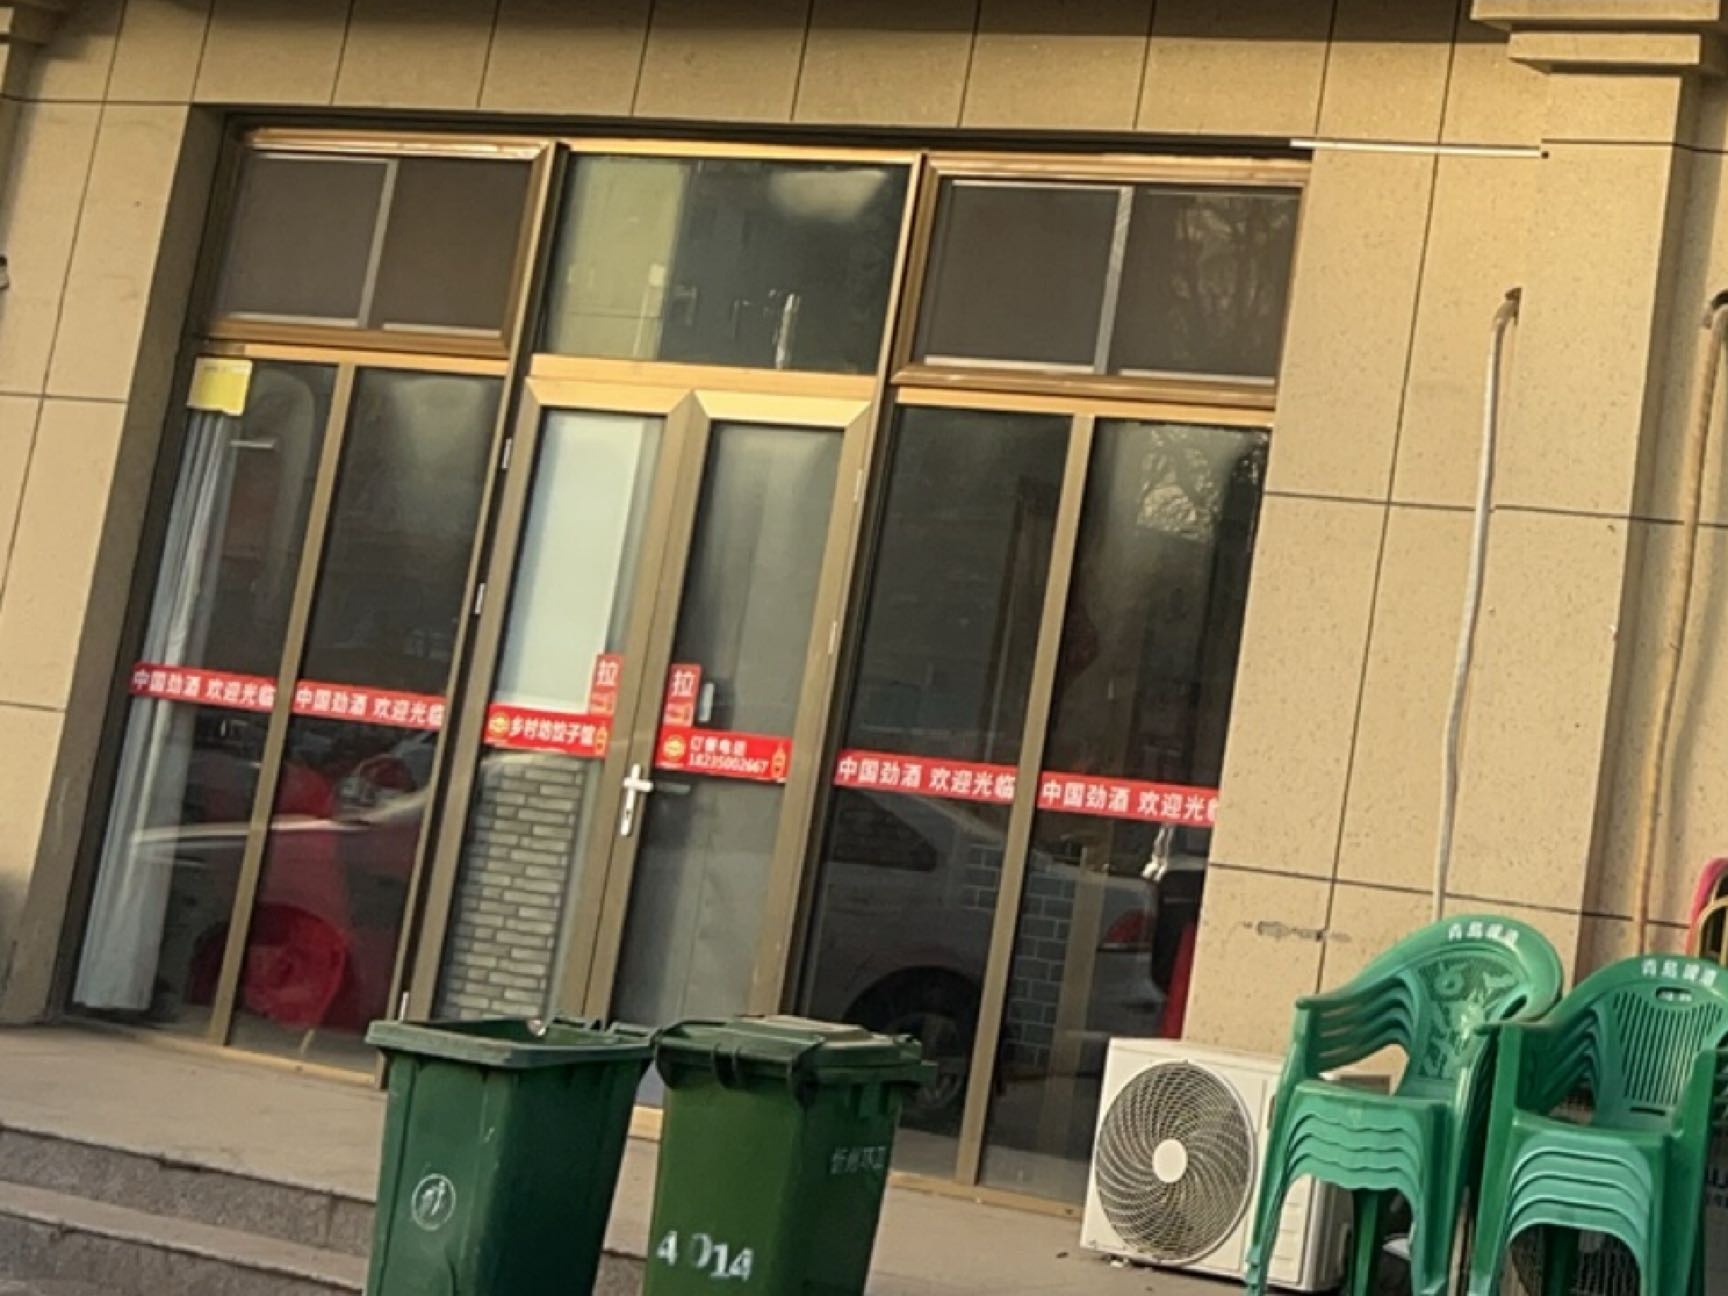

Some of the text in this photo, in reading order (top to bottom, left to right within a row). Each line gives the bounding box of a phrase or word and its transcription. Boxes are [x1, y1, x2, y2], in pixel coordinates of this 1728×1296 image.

[205, 676, 275, 708] 欢迎光临
[670, 669, 694, 696] 拉
[373, 696, 446, 727] 欢迎光临
[838, 755, 1017, 801] 中国劲酒 欢迎光临
[1041, 778, 1131, 813] 中国劲酒
